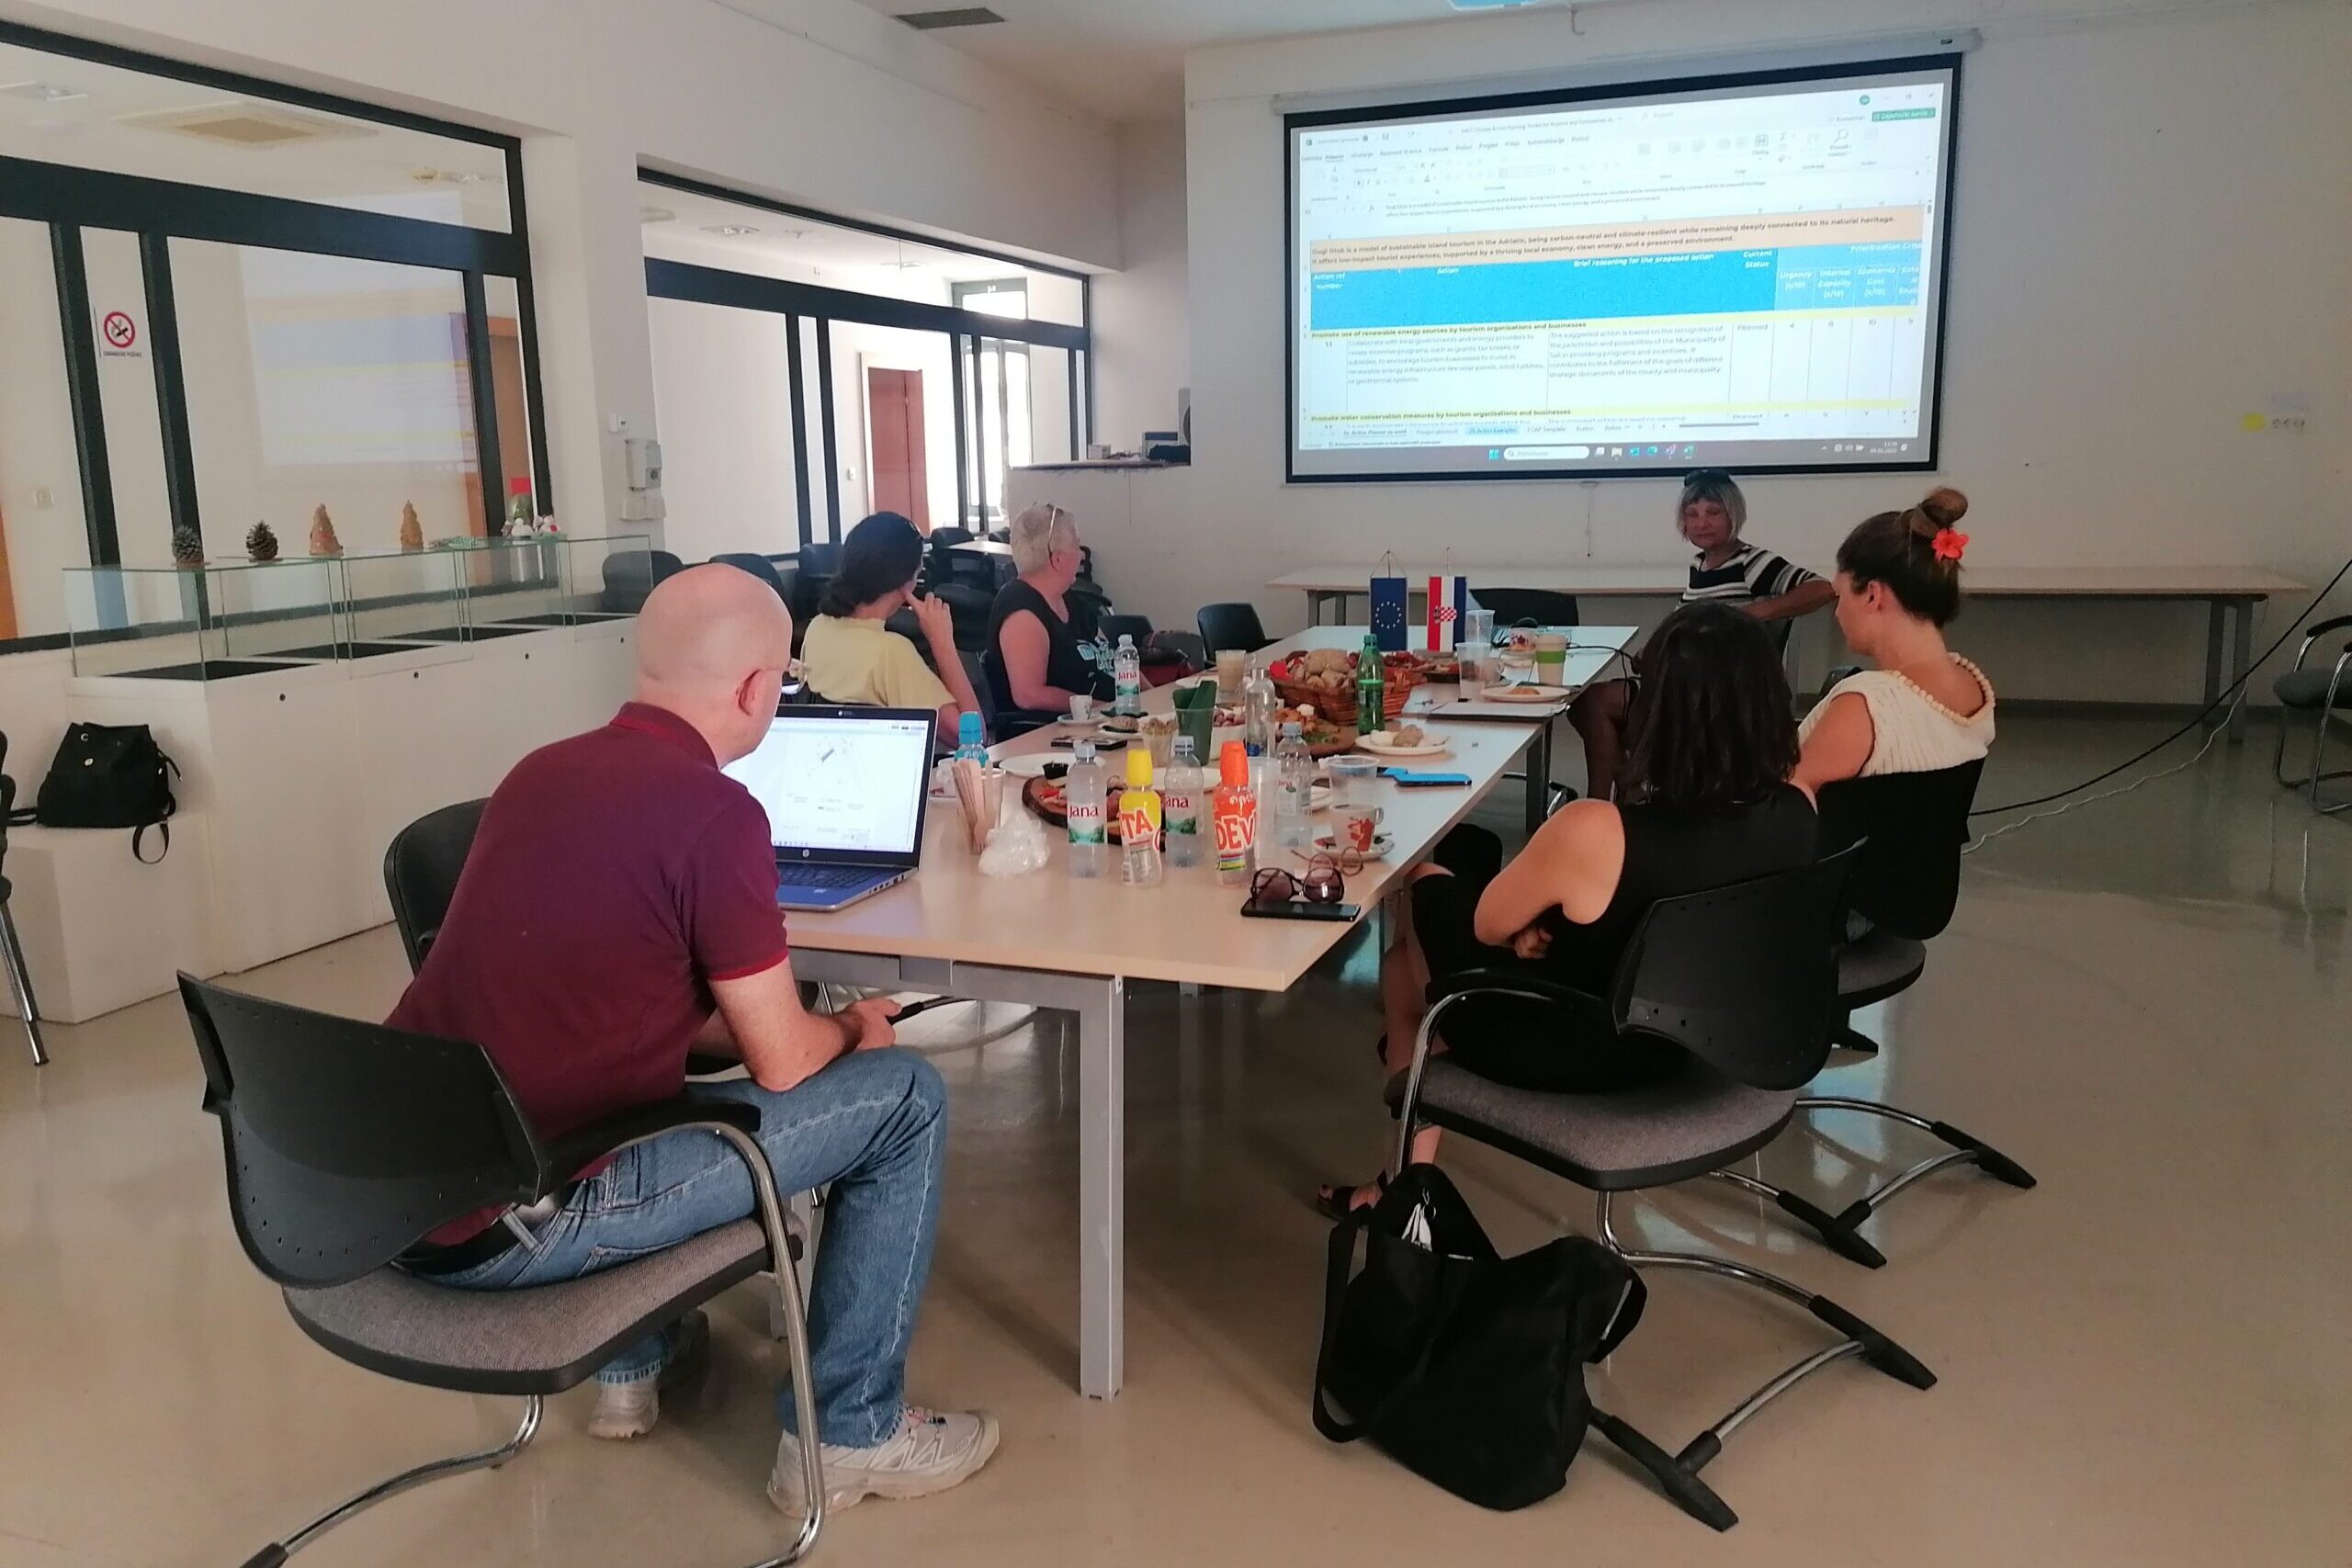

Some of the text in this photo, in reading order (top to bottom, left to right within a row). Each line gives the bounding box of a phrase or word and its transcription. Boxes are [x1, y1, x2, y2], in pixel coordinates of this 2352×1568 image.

[1312, 247, 1328, 255] Dugi
[1388, 242, 1426, 250] sustainable
[1498, 236, 1526, 245] Adriatic,
[1528, 234, 1548, 243] being
[1549, 231, 1601, 241] carbon-neutral
[1618, 227, 1677, 237] climate-resilient
[1700, 223, 1738, 234] remaining
[1740, 222, 1765, 232] deeply
[1767, 220, 1807, 229] connected
[1830, 217, 1859, 225] natural
[1860, 215, 1894, 226] heritage.
[1338, 254, 1374, 264] low-impact
[1399, 251, 1442, 261] experiences,
[1442, 248, 1477, 258] supported
[1495, 246, 1521, 255] thriving
[1541, 244, 1575, 253] economy,
[1597, 242, 1623, 250] energy,
[1646, 237, 1683, 247] preserved
[1685, 234, 1734, 243] environment.
[1743, 249, 1772, 257] Current
[1592, 256, 1627, 267] reasoning
[1655, 253, 1689, 264] proposed
[1690, 252, 1713, 260] action
[1745, 259, 1769, 268] Status
[1780, 271, 1812, 280] Urgency
[1487, 323, 1532, 333] organisations
[1472, 410, 1517, 418] organisations
[1166, 796, 1189, 808] ana
[1069, 806, 1099, 818] Jana
